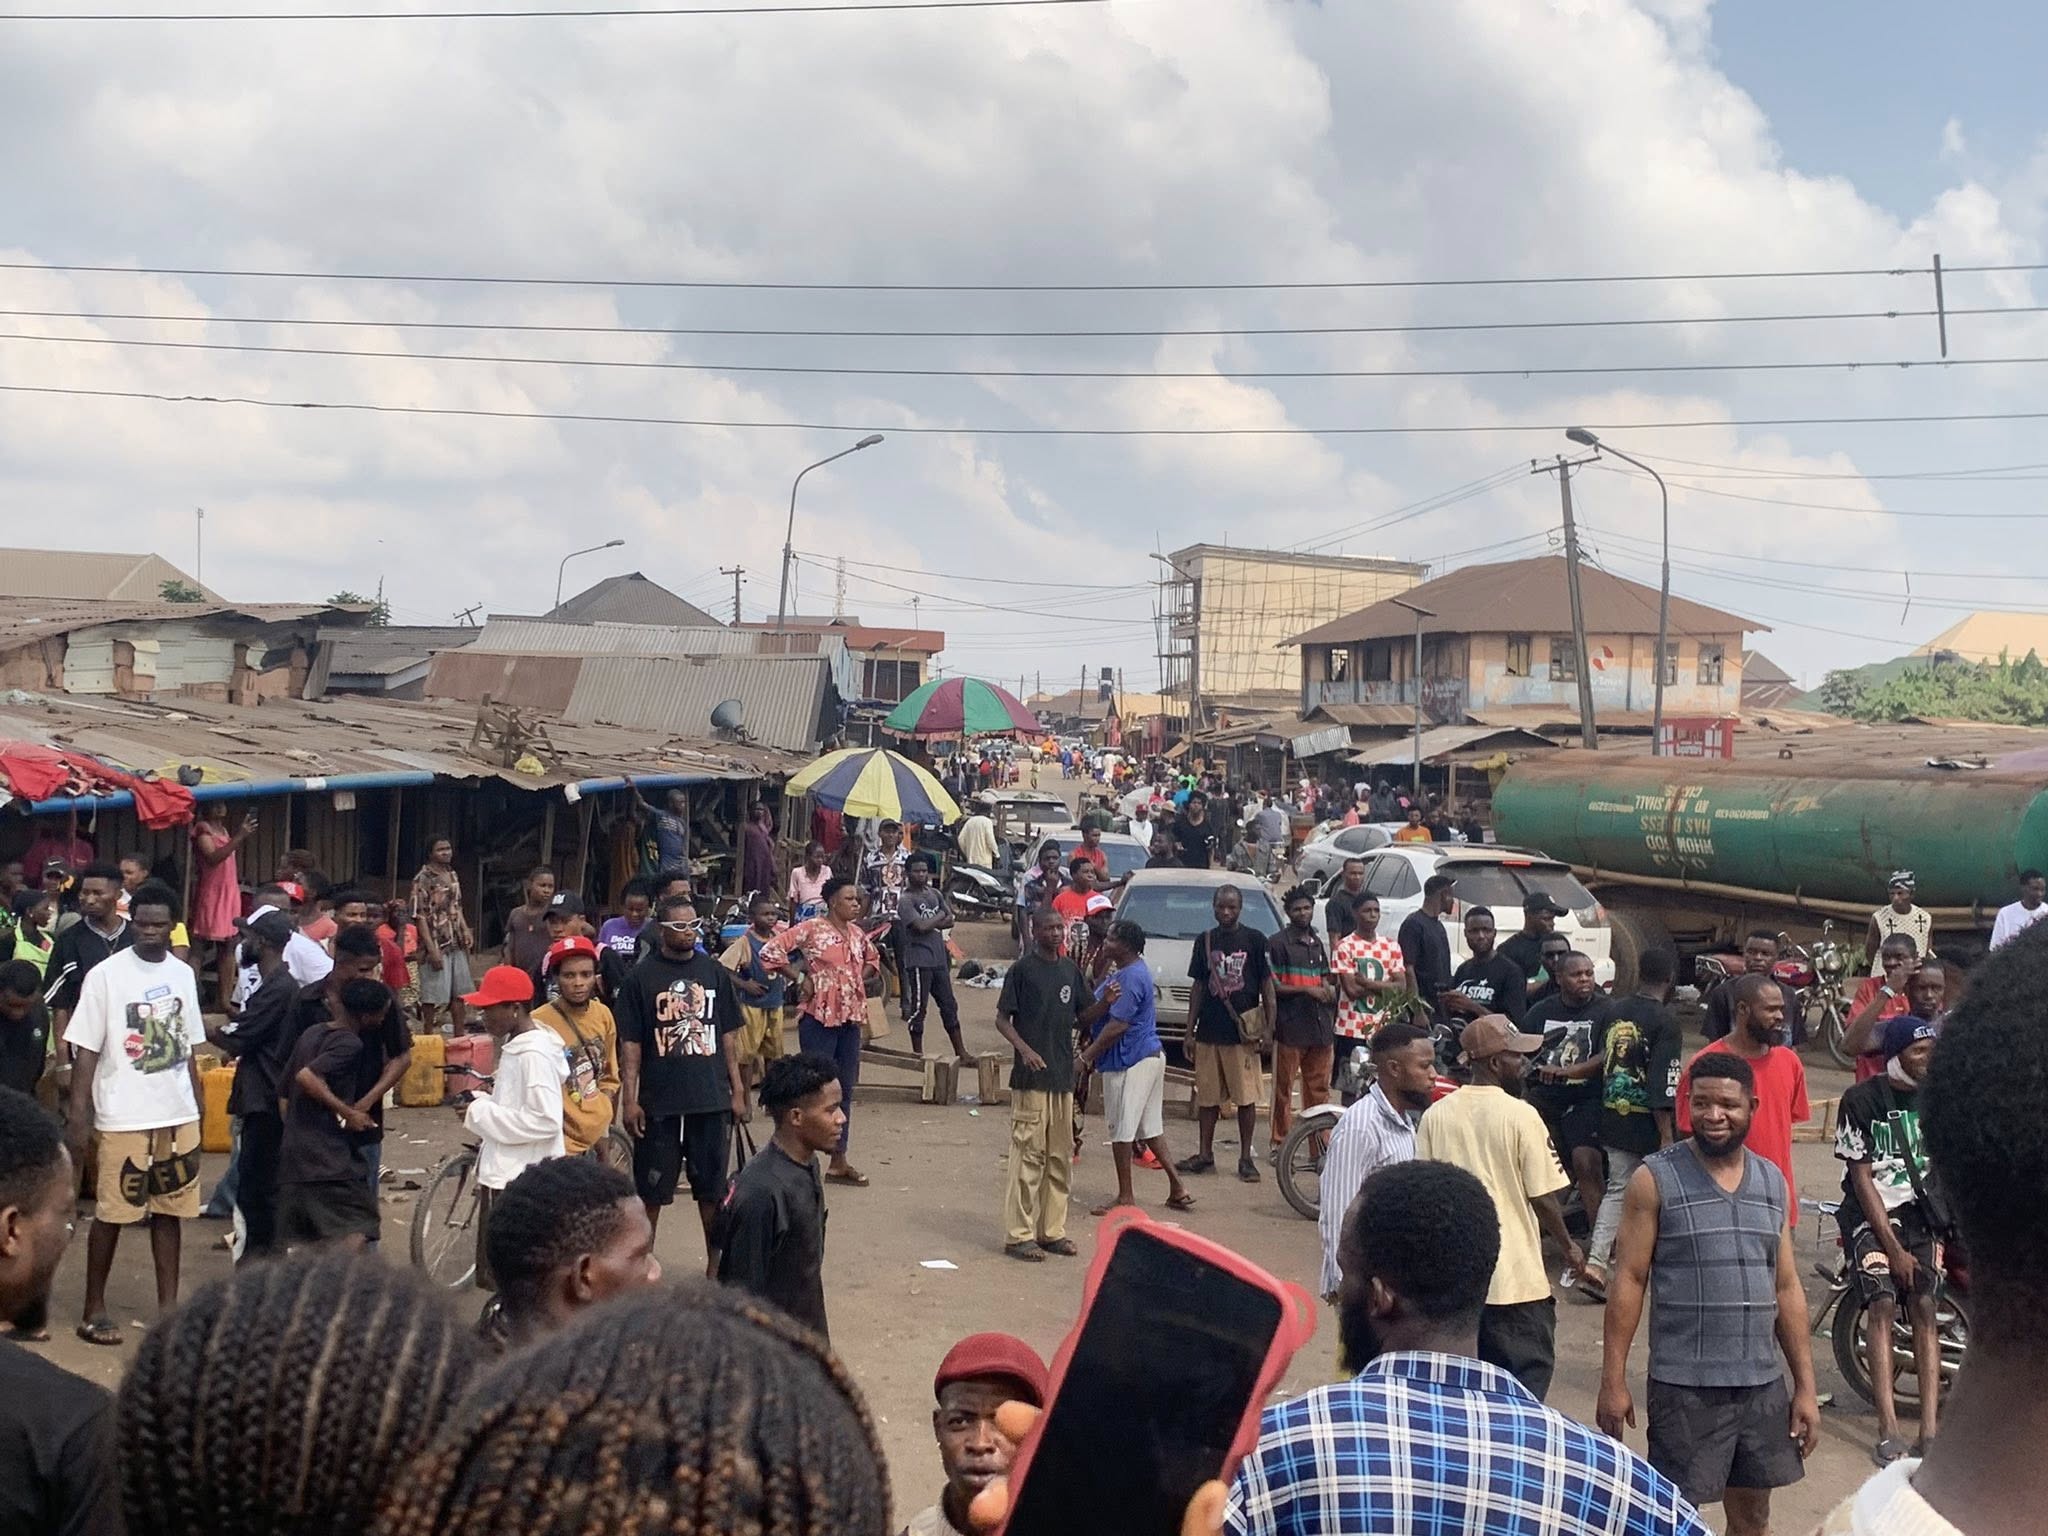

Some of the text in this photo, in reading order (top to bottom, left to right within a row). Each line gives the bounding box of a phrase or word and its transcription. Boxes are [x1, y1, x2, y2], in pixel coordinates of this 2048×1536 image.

[1634, 794, 1665, 811] SHALL
[1663, 797, 1688, 813] MN
[1685, 818, 1711, 835] HAS
